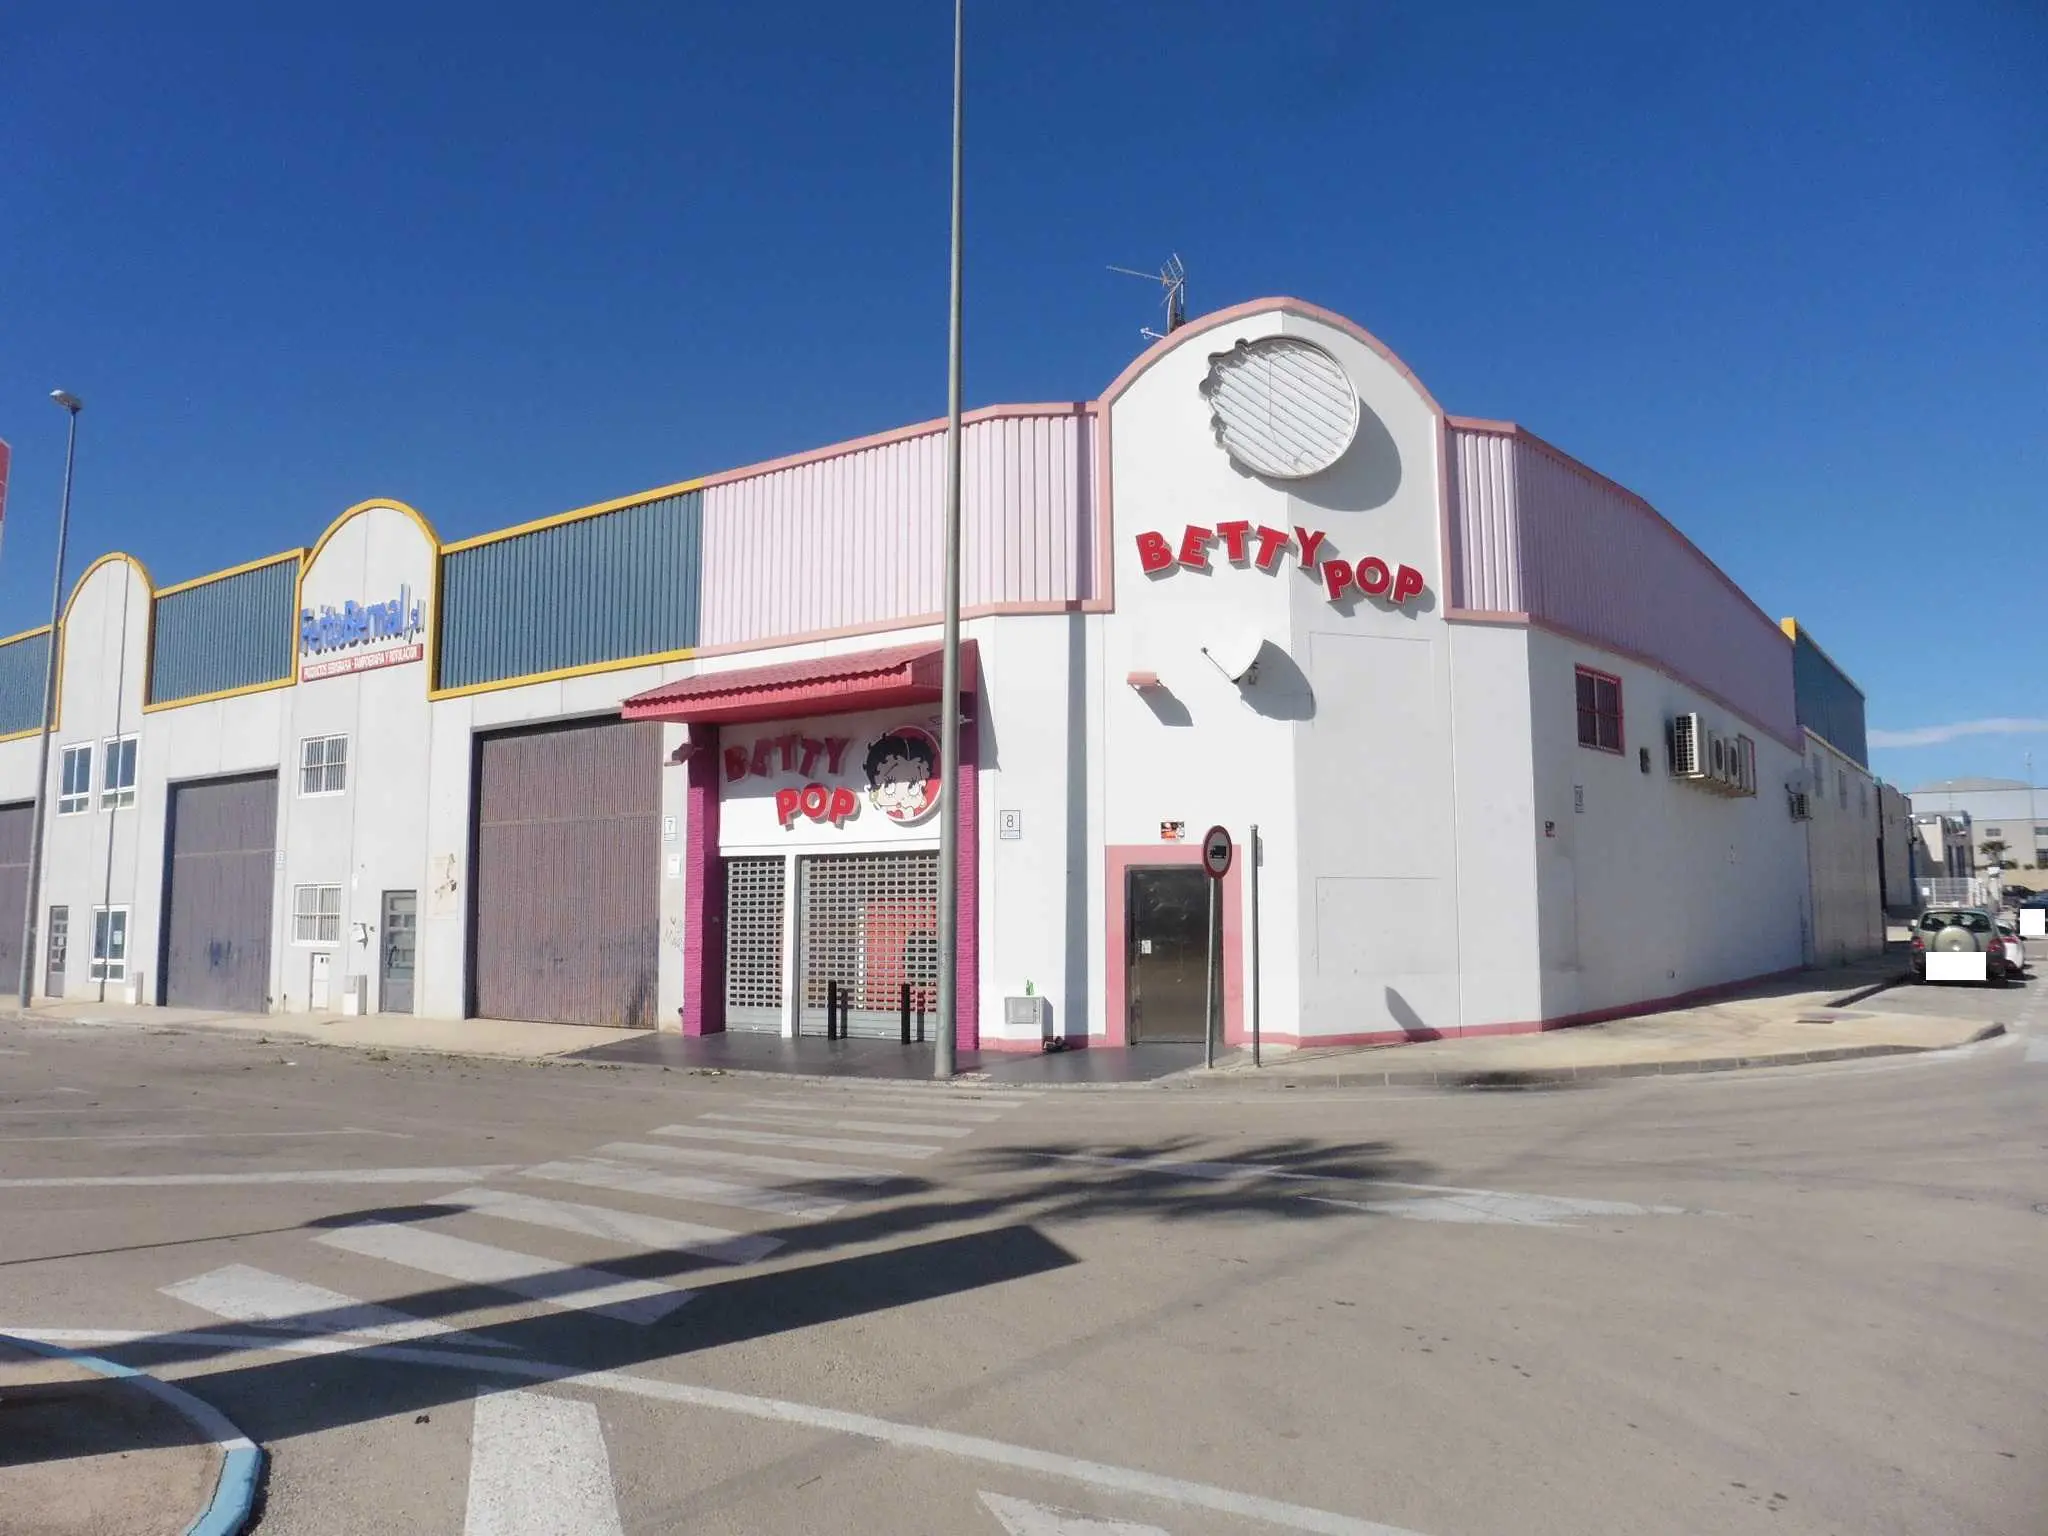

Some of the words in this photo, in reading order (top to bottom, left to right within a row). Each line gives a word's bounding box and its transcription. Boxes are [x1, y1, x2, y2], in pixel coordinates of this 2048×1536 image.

[1135, 520, 1326, 574] BETTY
[1321, 556, 1424, 604] POP
[724, 734, 851, 783] BETTY
[775, 784, 857, 828] POP
[1007, 815, 1013, 828] 8
